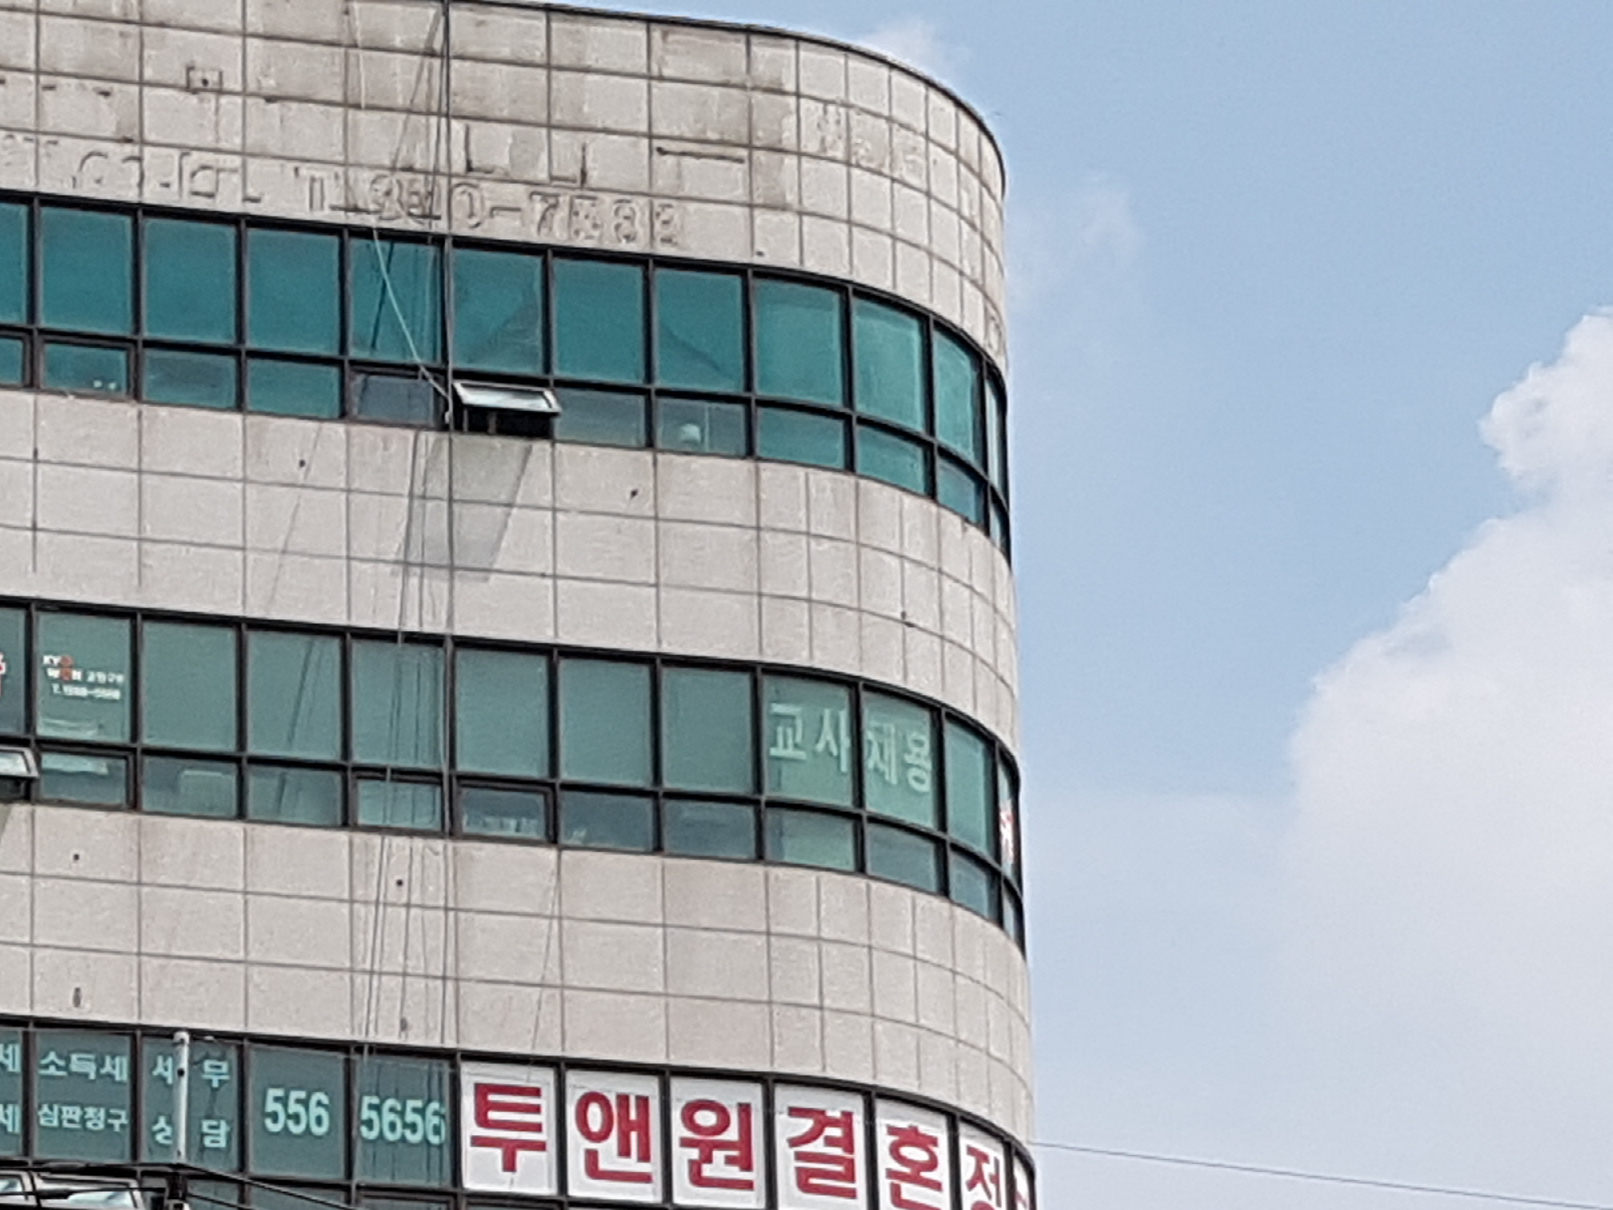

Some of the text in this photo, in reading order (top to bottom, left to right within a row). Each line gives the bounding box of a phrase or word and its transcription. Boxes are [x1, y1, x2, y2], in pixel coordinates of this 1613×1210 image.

[37, 1048, 129, 1084] 소득세
[37, 1102, 129, 1134] 심판청구
[263, 1088, 447, 1146] 556 5656
